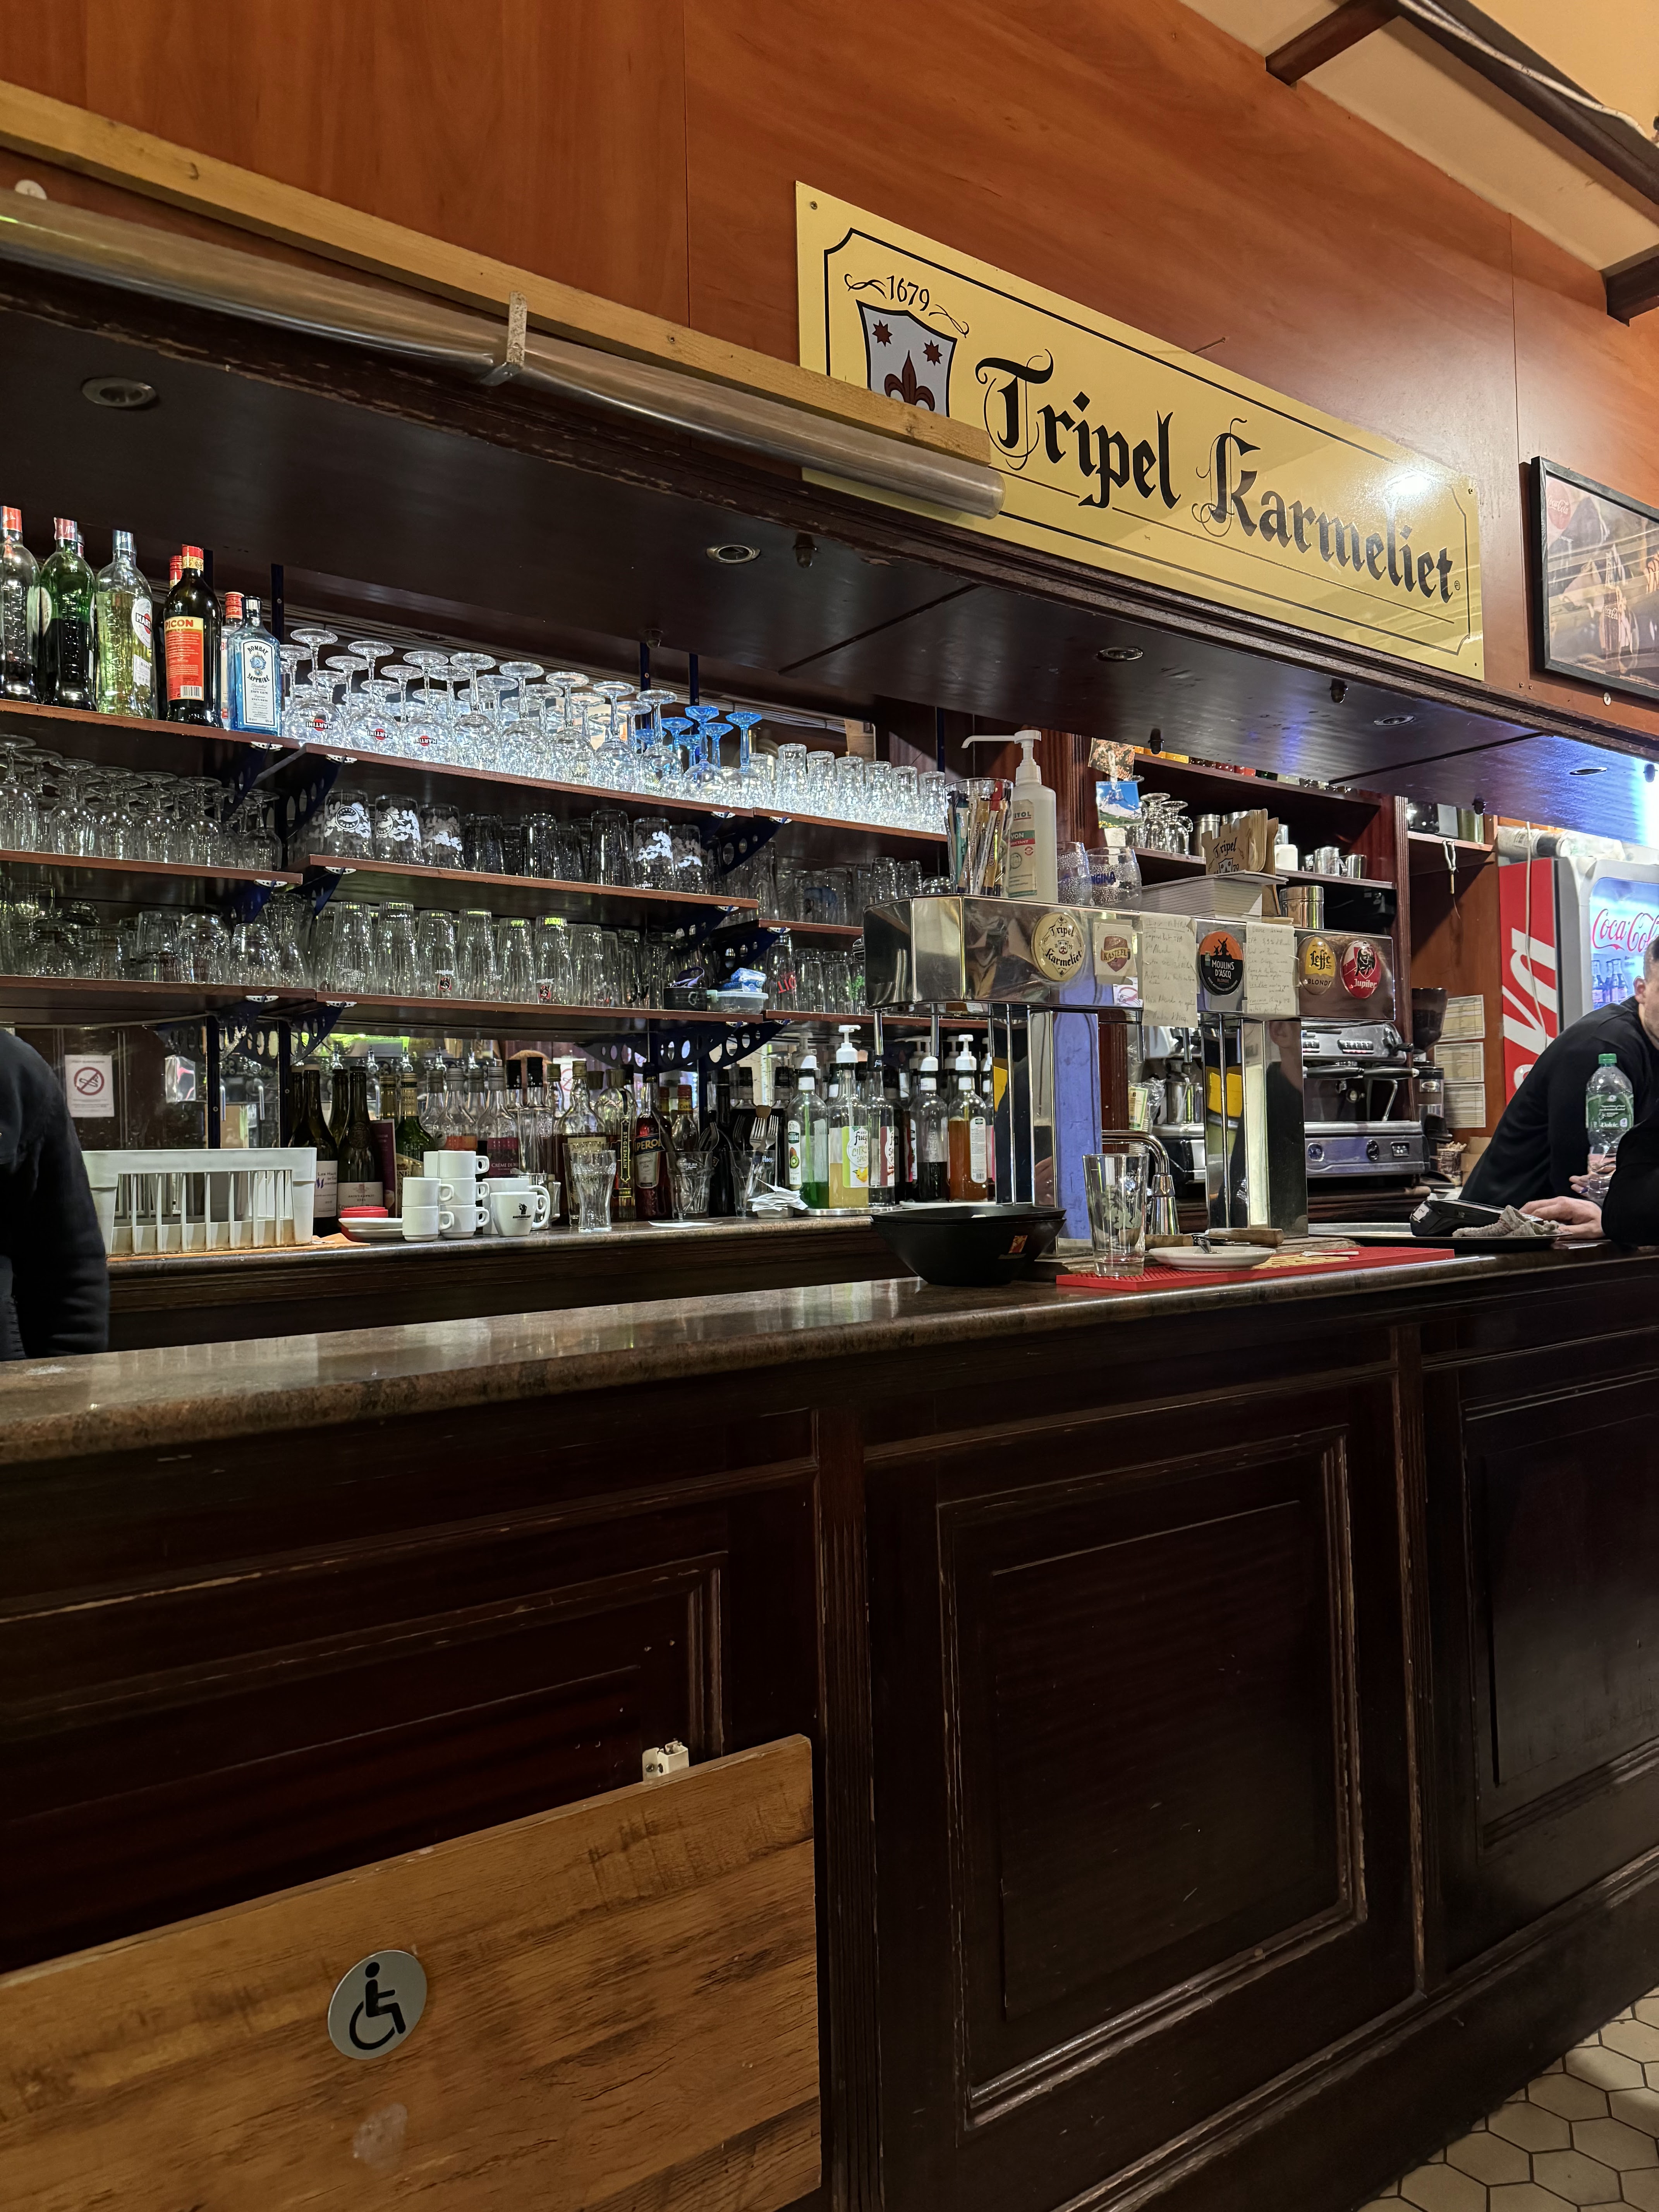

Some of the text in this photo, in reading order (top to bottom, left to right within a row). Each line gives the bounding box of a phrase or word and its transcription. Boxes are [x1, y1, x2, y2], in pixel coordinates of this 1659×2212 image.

[886, 275, 929, 311] 1679
[975, 349, 1455, 603] Tripel Karmeliet
[136, 613, 151, 629] MART
[165, 620, 193, 629] PICON
[247, 646, 268, 655] BOMBAY
[247, 673, 270, 683] SAPPHIRE
[306, 721, 333, 730] MARTINI
[368, 730, 392, 739] MARTINI
[1213, 836, 1237, 858] Tripel
[1092, 871, 1116, 885] NGINA
[1049, 924, 1075, 937] Tripel
[1592, 908, 1659, 953] Coca-Col
[1046, 948, 1083, 967] Karmeliet
[1104, 949, 1127, 960] KASTEEL
[1310, 949, 1331, 970] Leffe
[1212, 960, 1235, 970] MOULINS
[1215, 969, 1231, 979] D'ASCQ
[1354, 979, 1377, 989] Jupiler
